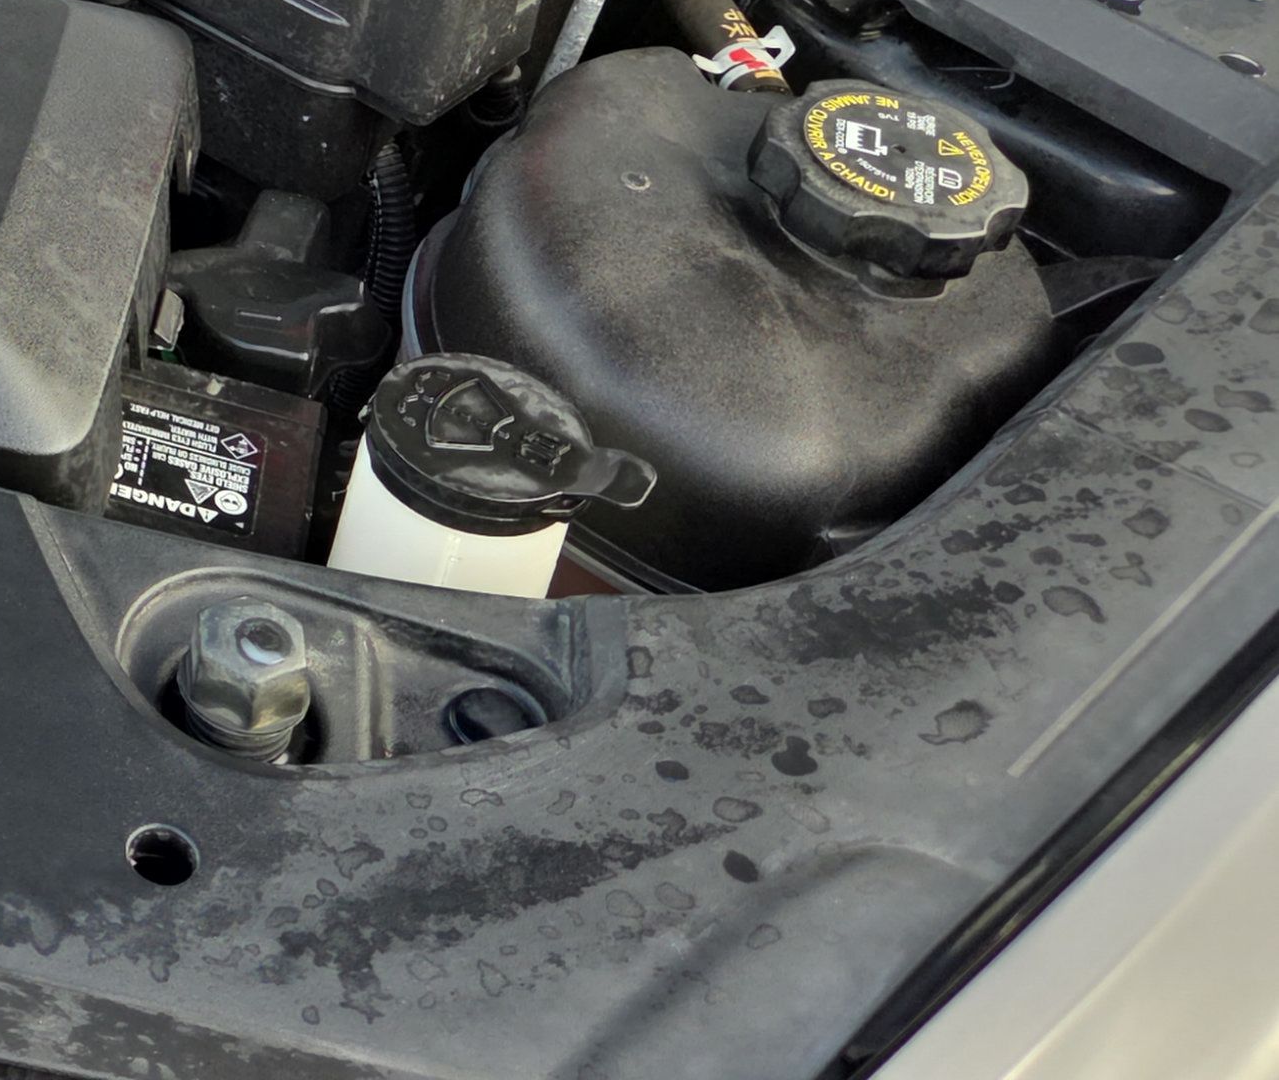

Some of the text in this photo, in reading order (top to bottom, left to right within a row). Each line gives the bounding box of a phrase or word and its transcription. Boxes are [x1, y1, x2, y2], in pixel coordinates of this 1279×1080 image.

[821, 95, 871, 112] JAMAIS
[874, 95, 899, 109] NE
[808, 109, 828, 149] OUVRIR
[952, 131, 987, 166] NEVER
[971, 166, 990, 192] OPEN
[150, 409, 170, 421] HELP
[171, 414, 205, 430] MEDICAL
[205, 423, 220, 434] GET
[171, 434, 191, 446] EYES
[191, 439, 217, 453] FLUSH
[197, 432, 218, 445] WITH
[177, 449, 189, 459] OR
[167, 455, 198, 471] GASES
[199, 464, 250, 485] EXPLOSIVE
[215, 477, 249, 494] SHIELD
